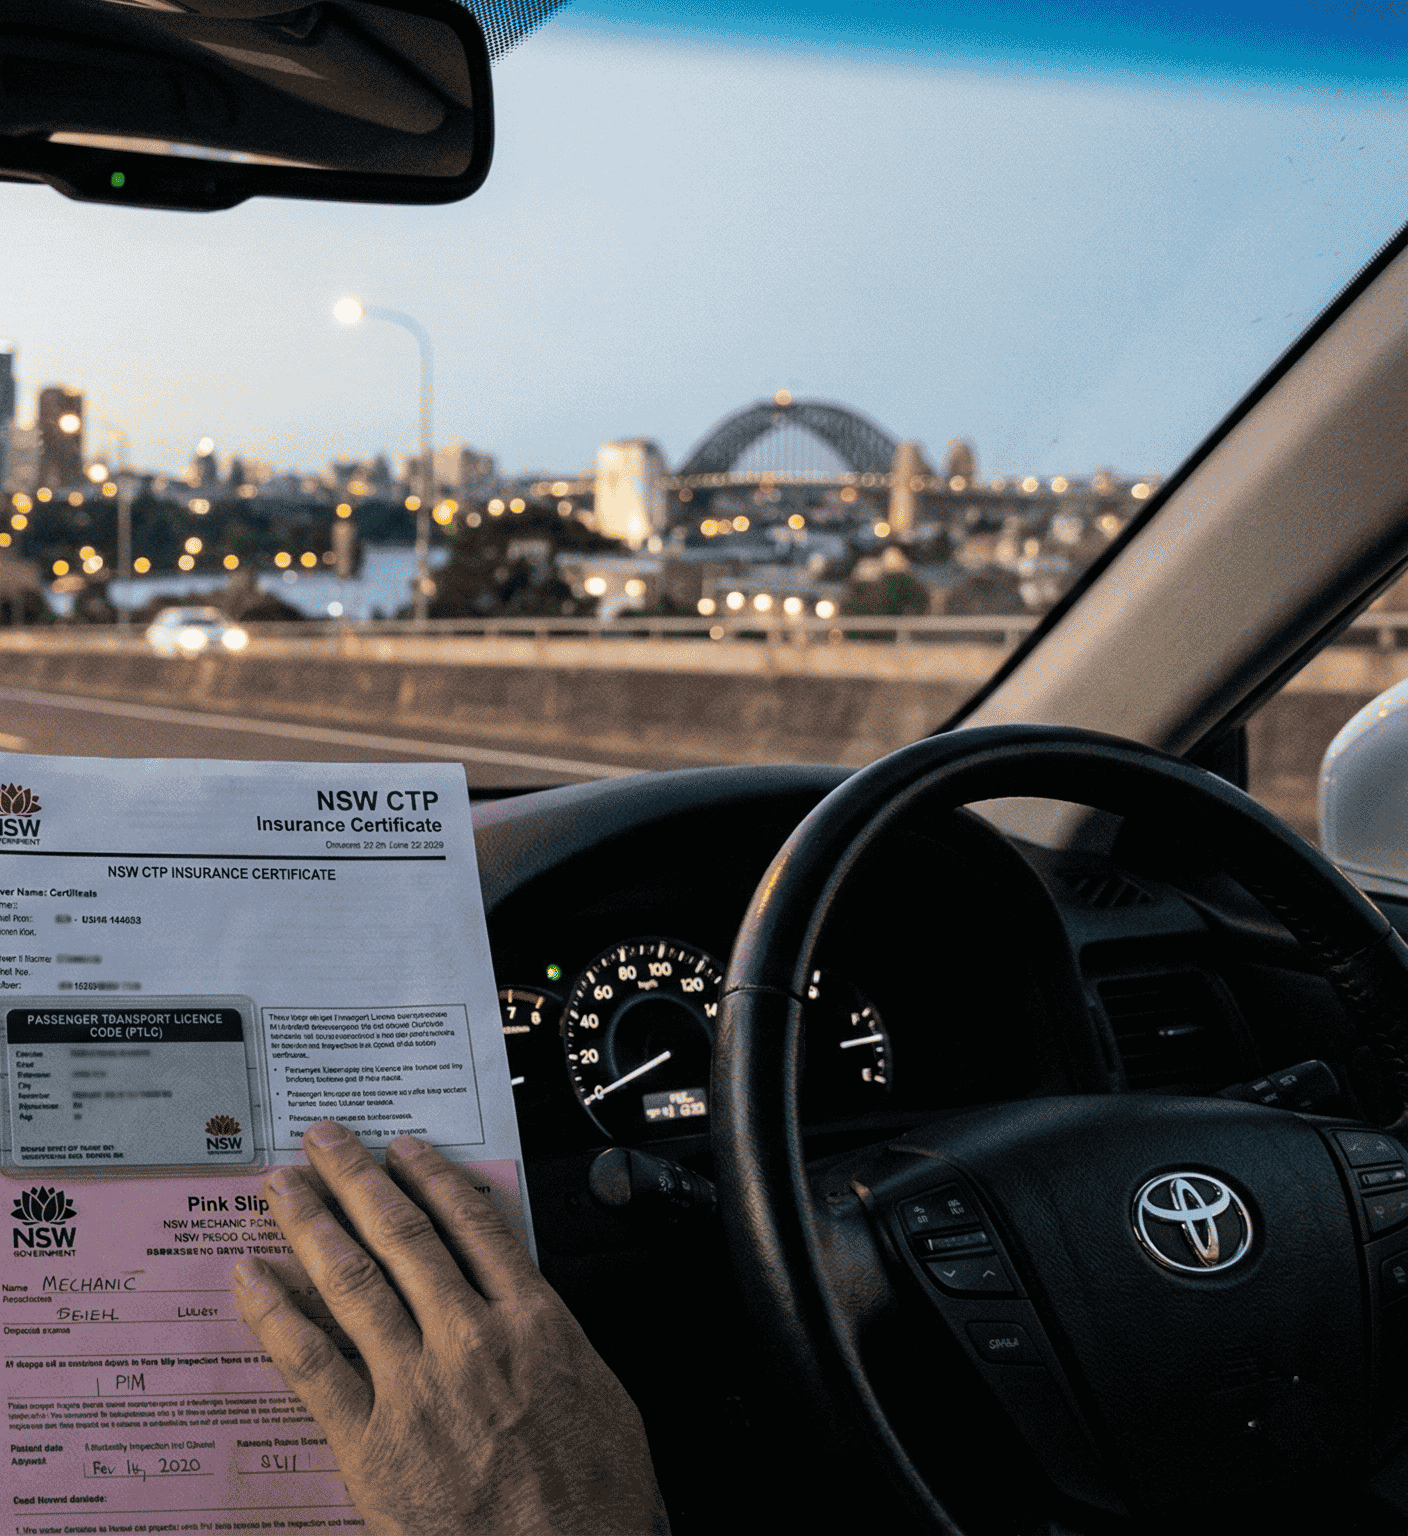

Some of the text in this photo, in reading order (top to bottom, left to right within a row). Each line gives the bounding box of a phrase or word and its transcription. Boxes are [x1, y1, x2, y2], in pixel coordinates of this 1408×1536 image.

[316, 790, 439, 812] NSW CTP
[256, 815, 442, 833] Insurance Certificate
[107, 866, 337, 881] NSW CTP INSURANCE CERTIFICATE
[16, 887, 48, 898] Name:
[617, 965, 638, 981] 80
[648, 961, 673, 977] 100
[593, 984, 614, 1001] 60
[680, 976, 705, 993] 120
[27, 1013, 99, 1026] PASSENGER
[173, 1013, 223, 1025] LICENCE
[506, 1005, 517, 1020] 7
[579, 1013, 600, 1029] 40
[89, 1026, 123, 1039] CODE
[579, 1048, 600, 1065] 20
[206, 1137, 243, 1151] NSW
[187, 1195, 271, 1216] Pink Slip
[163, 1219, 189, 1229] NSW
[191, 1218, 247, 1229] MECHANIC
[13, 1227, 77, 1249] NSW
[1, 1284, 29, 1293] Name
[42, 1275, 138, 1293] MECHANIC
[158, 1457, 202, 1473] 2020
